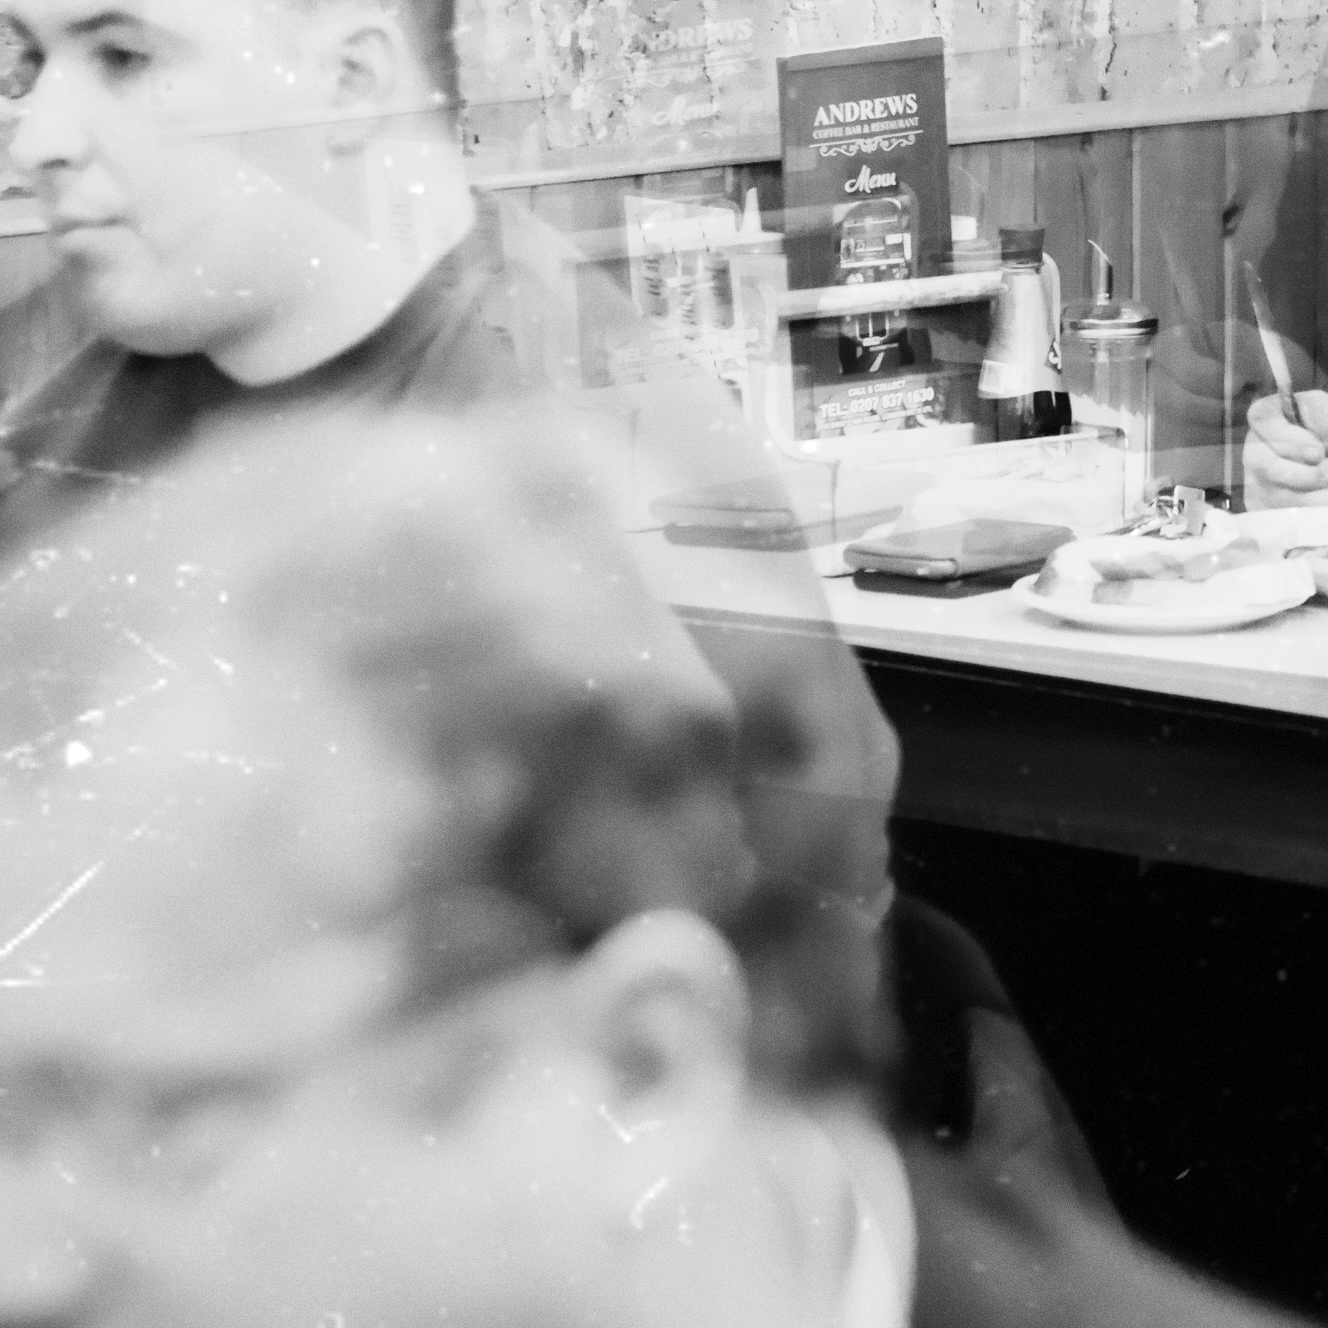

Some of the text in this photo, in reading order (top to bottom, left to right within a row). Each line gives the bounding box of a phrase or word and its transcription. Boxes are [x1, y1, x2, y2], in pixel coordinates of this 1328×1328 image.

[813, 93, 919, 127] ANDREWS
[844, 164, 897, 194] Menu
[850, 396, 880, 412] 0207
